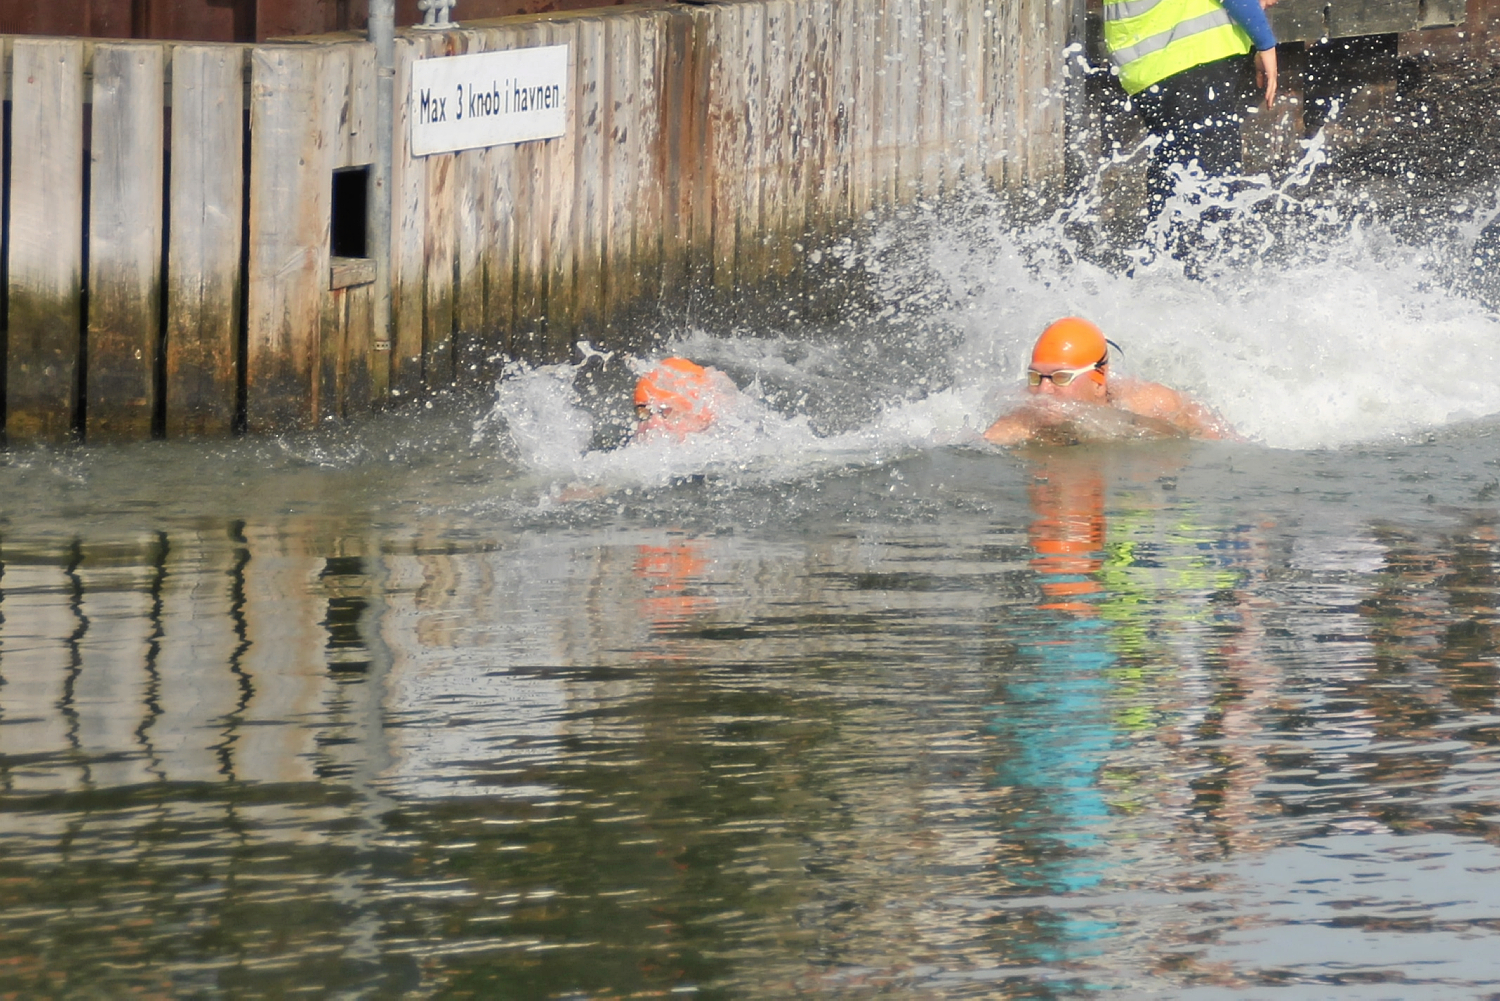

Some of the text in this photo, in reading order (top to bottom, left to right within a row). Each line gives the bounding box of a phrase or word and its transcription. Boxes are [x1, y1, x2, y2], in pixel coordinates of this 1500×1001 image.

[420, 78, 559, 124] Max 3 knob i havnen
